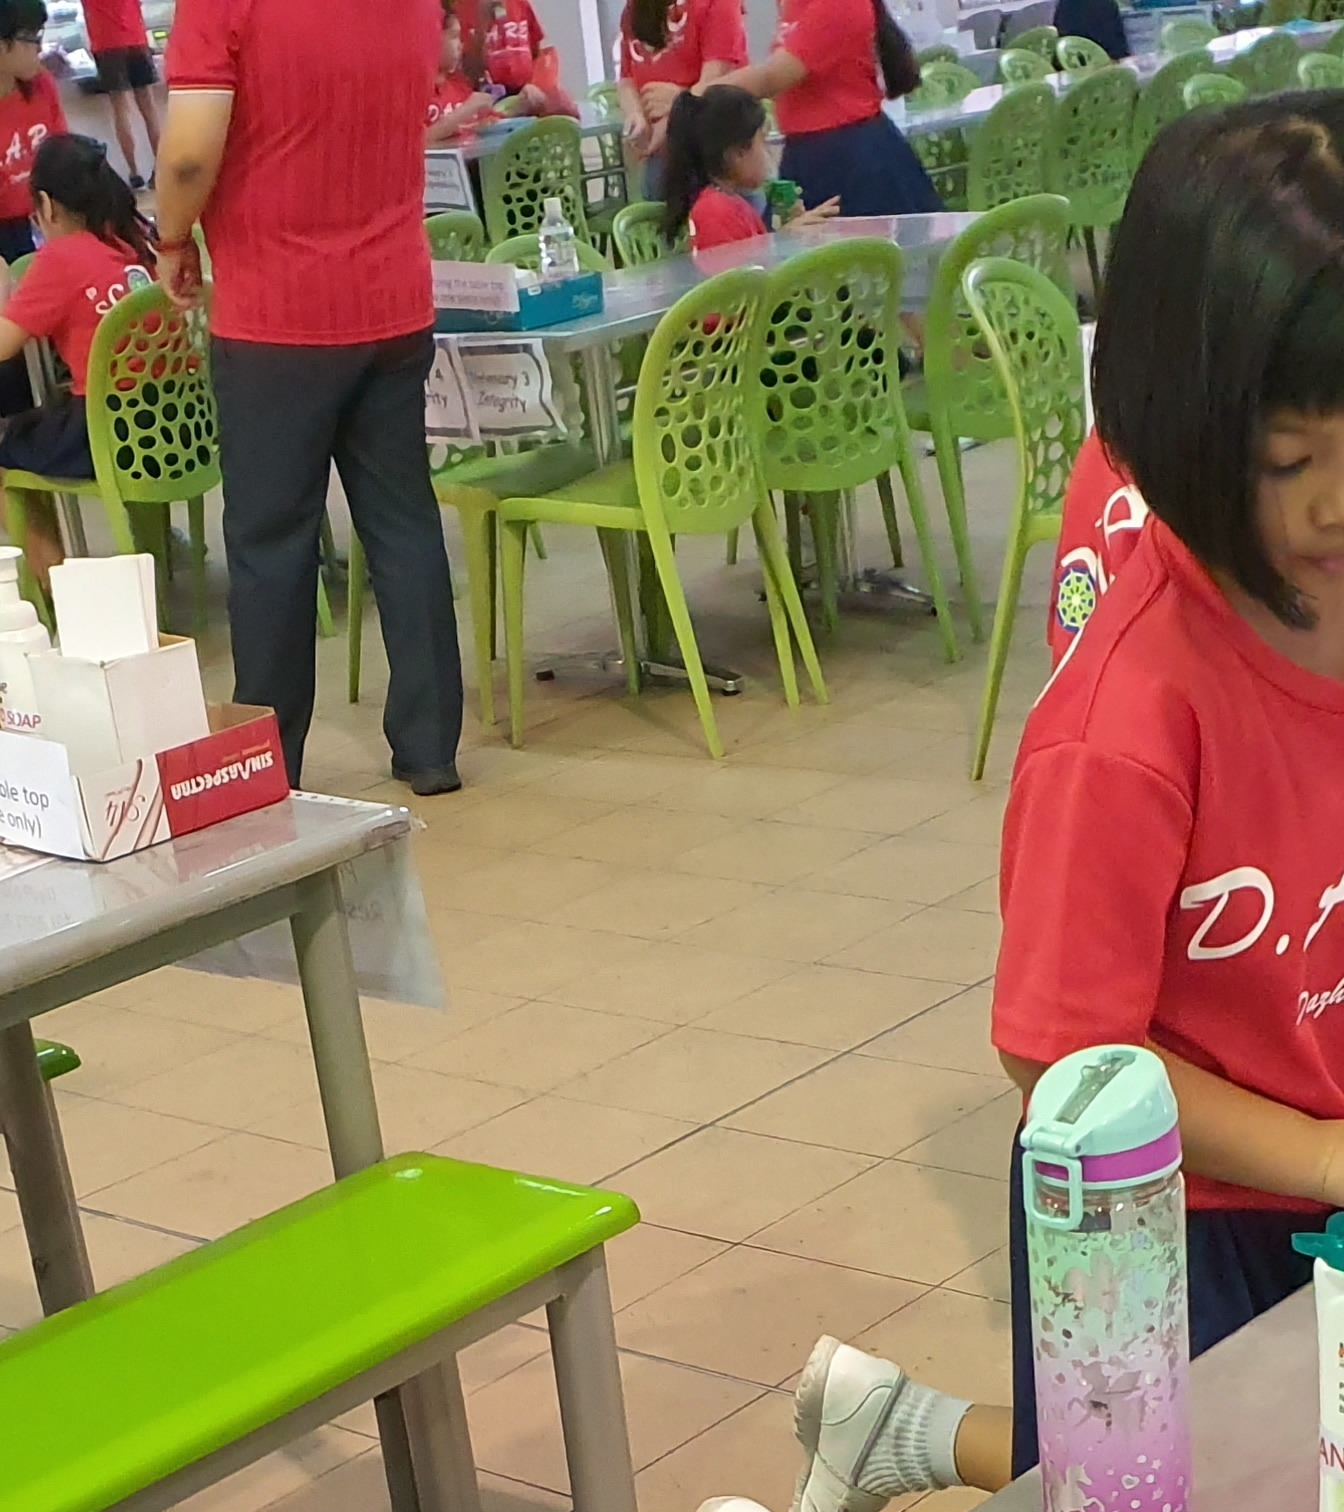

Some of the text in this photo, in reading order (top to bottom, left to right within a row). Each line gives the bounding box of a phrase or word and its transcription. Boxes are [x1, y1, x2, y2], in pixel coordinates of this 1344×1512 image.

[6, 710, 43, 729] SOAP
[22, 786, 50, 811] top
[6, 811, 43, 838] only)
